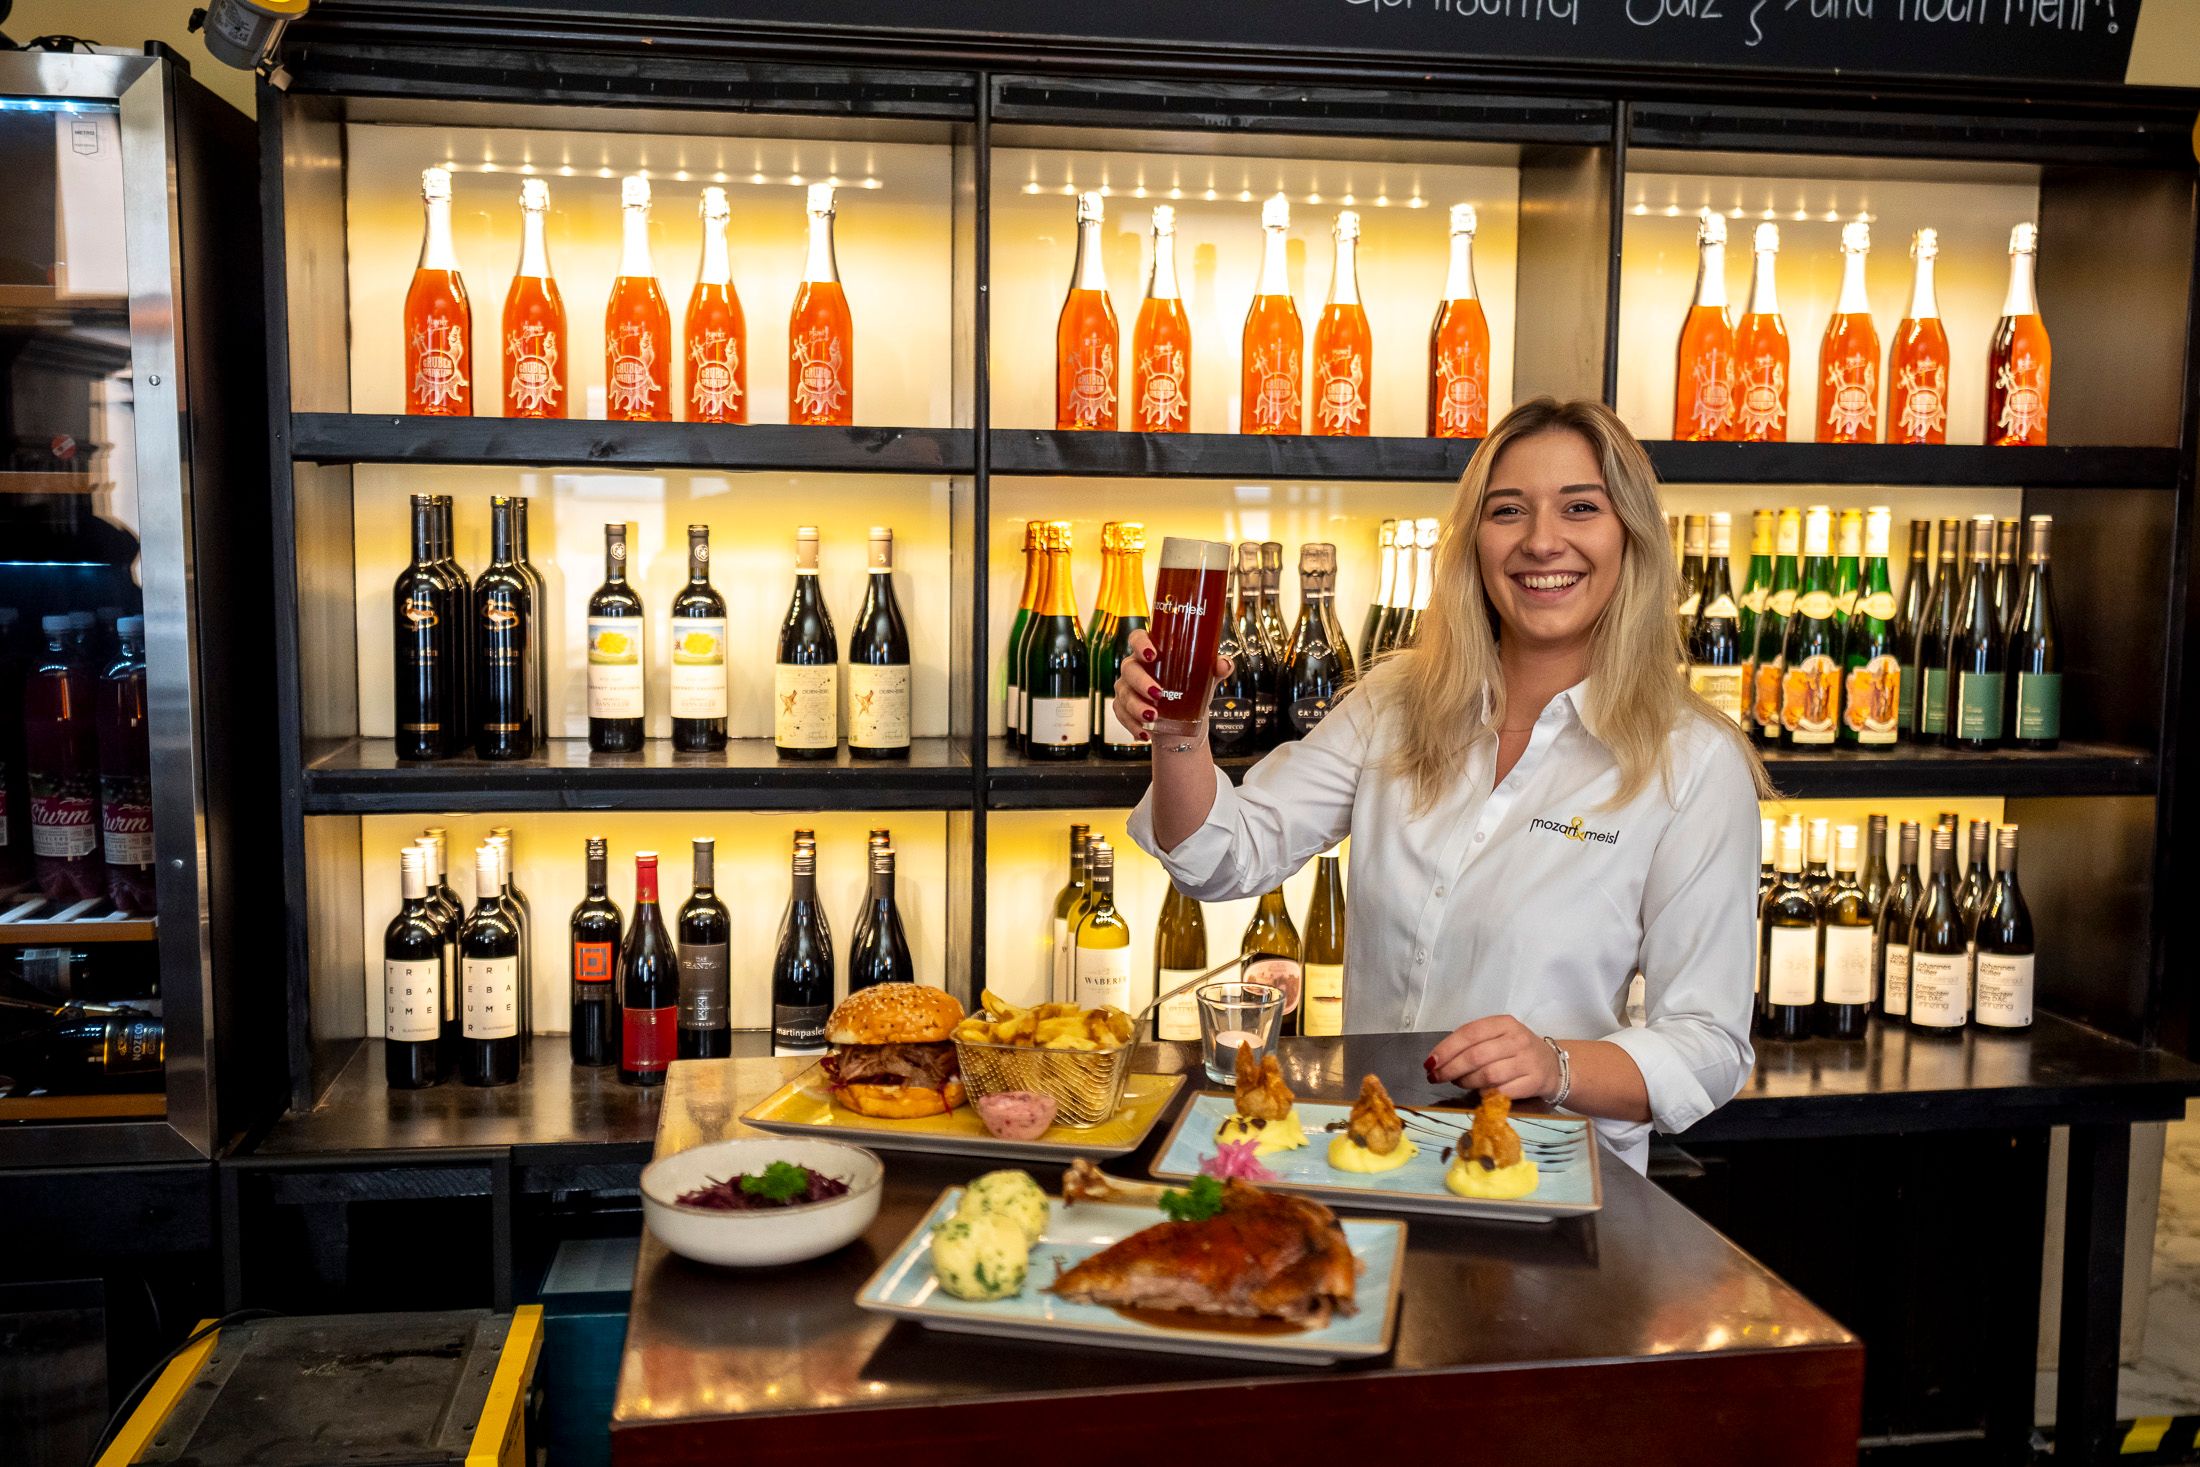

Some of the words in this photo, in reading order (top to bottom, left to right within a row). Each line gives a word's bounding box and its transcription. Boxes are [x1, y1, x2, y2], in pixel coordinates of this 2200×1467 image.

[32, 803, 92, 825] Sturm
[103, 812, 150, 831] turm
[132, 1023, 144, 1061] NOZECO
[776, 1027, 826, 1040] martinpasler
